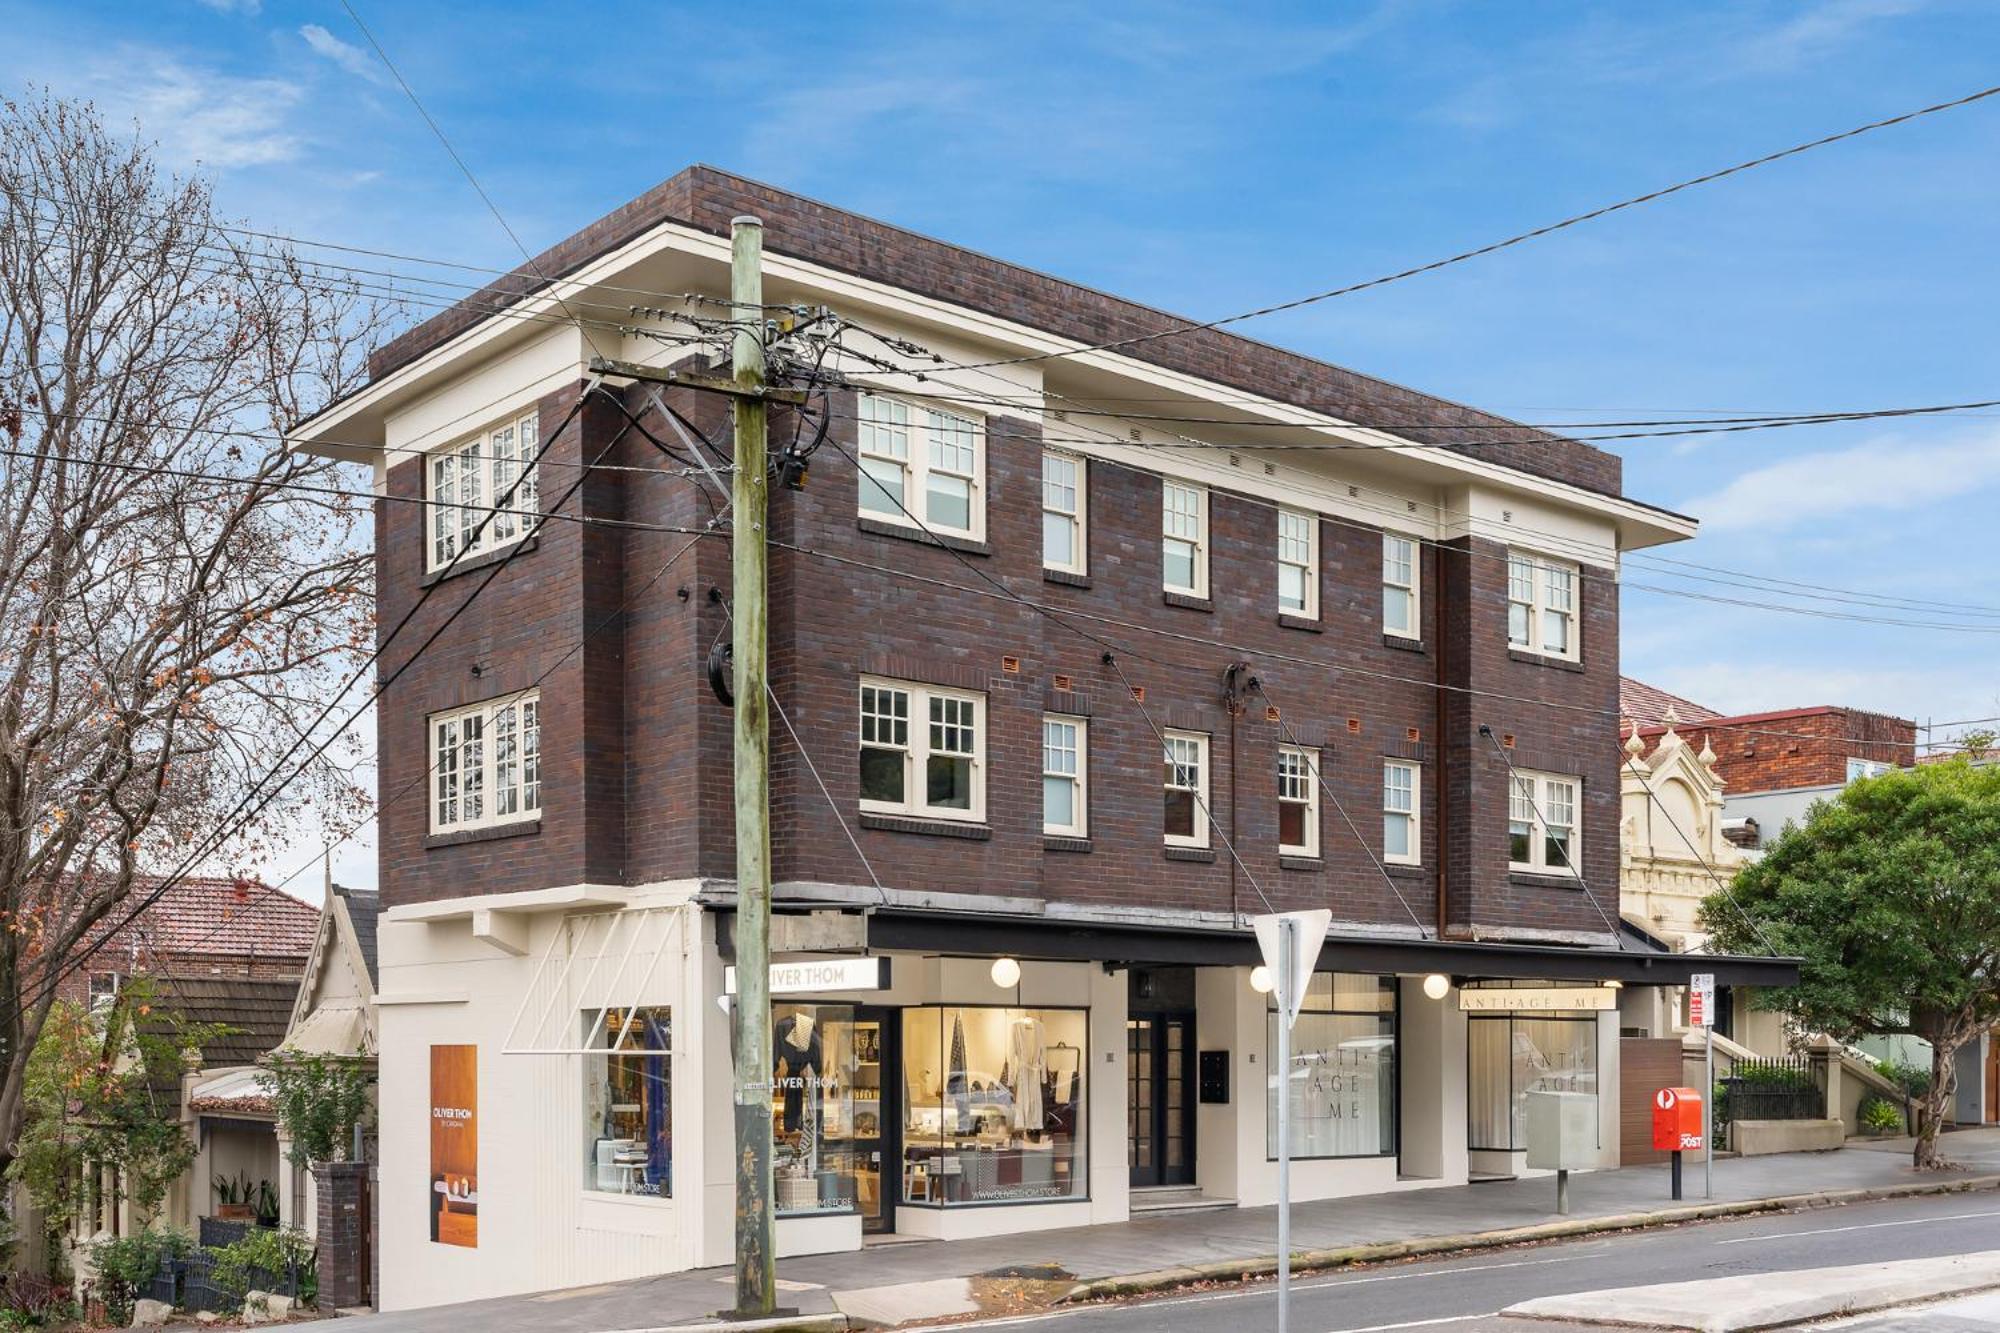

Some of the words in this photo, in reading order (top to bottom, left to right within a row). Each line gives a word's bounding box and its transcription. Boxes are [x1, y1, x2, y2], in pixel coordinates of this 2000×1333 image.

[771, 969, 801, 986] IVER
[805, 967, 845, 985] THOM
[1575, 996, 1600, 1009] ME
[807, 1076, 839, 1088] THOM
[1313, 1074, 1359, 1092] AGE
[1538, 1076, 1578, 1092] AGE
[1330, 1101, 1359, 1118] ME
[1680, 1136, 1702, 1149] POST
